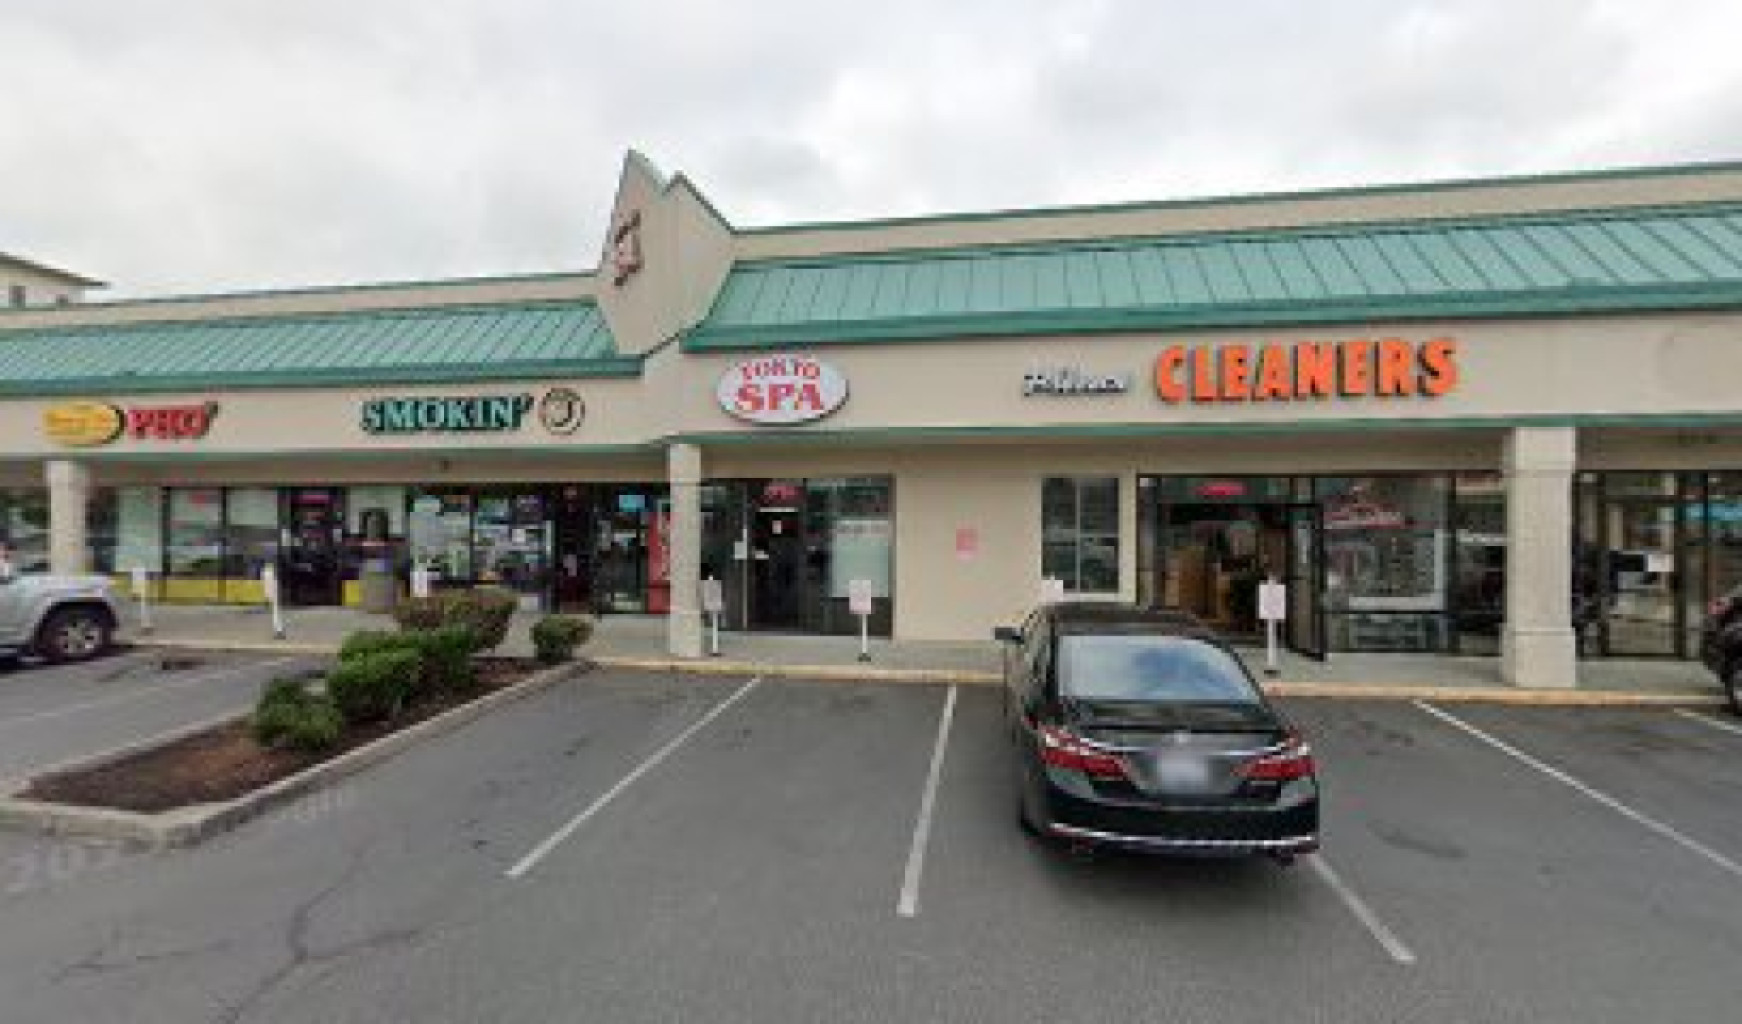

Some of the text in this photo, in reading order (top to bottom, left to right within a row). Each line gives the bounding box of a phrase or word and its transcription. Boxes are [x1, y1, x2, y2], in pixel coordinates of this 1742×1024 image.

[1154, 338, 1458, 405] CLEANERS
[361, 393, 534, 435] SMOKIN'
[736, 382, 824, 412] SPA
